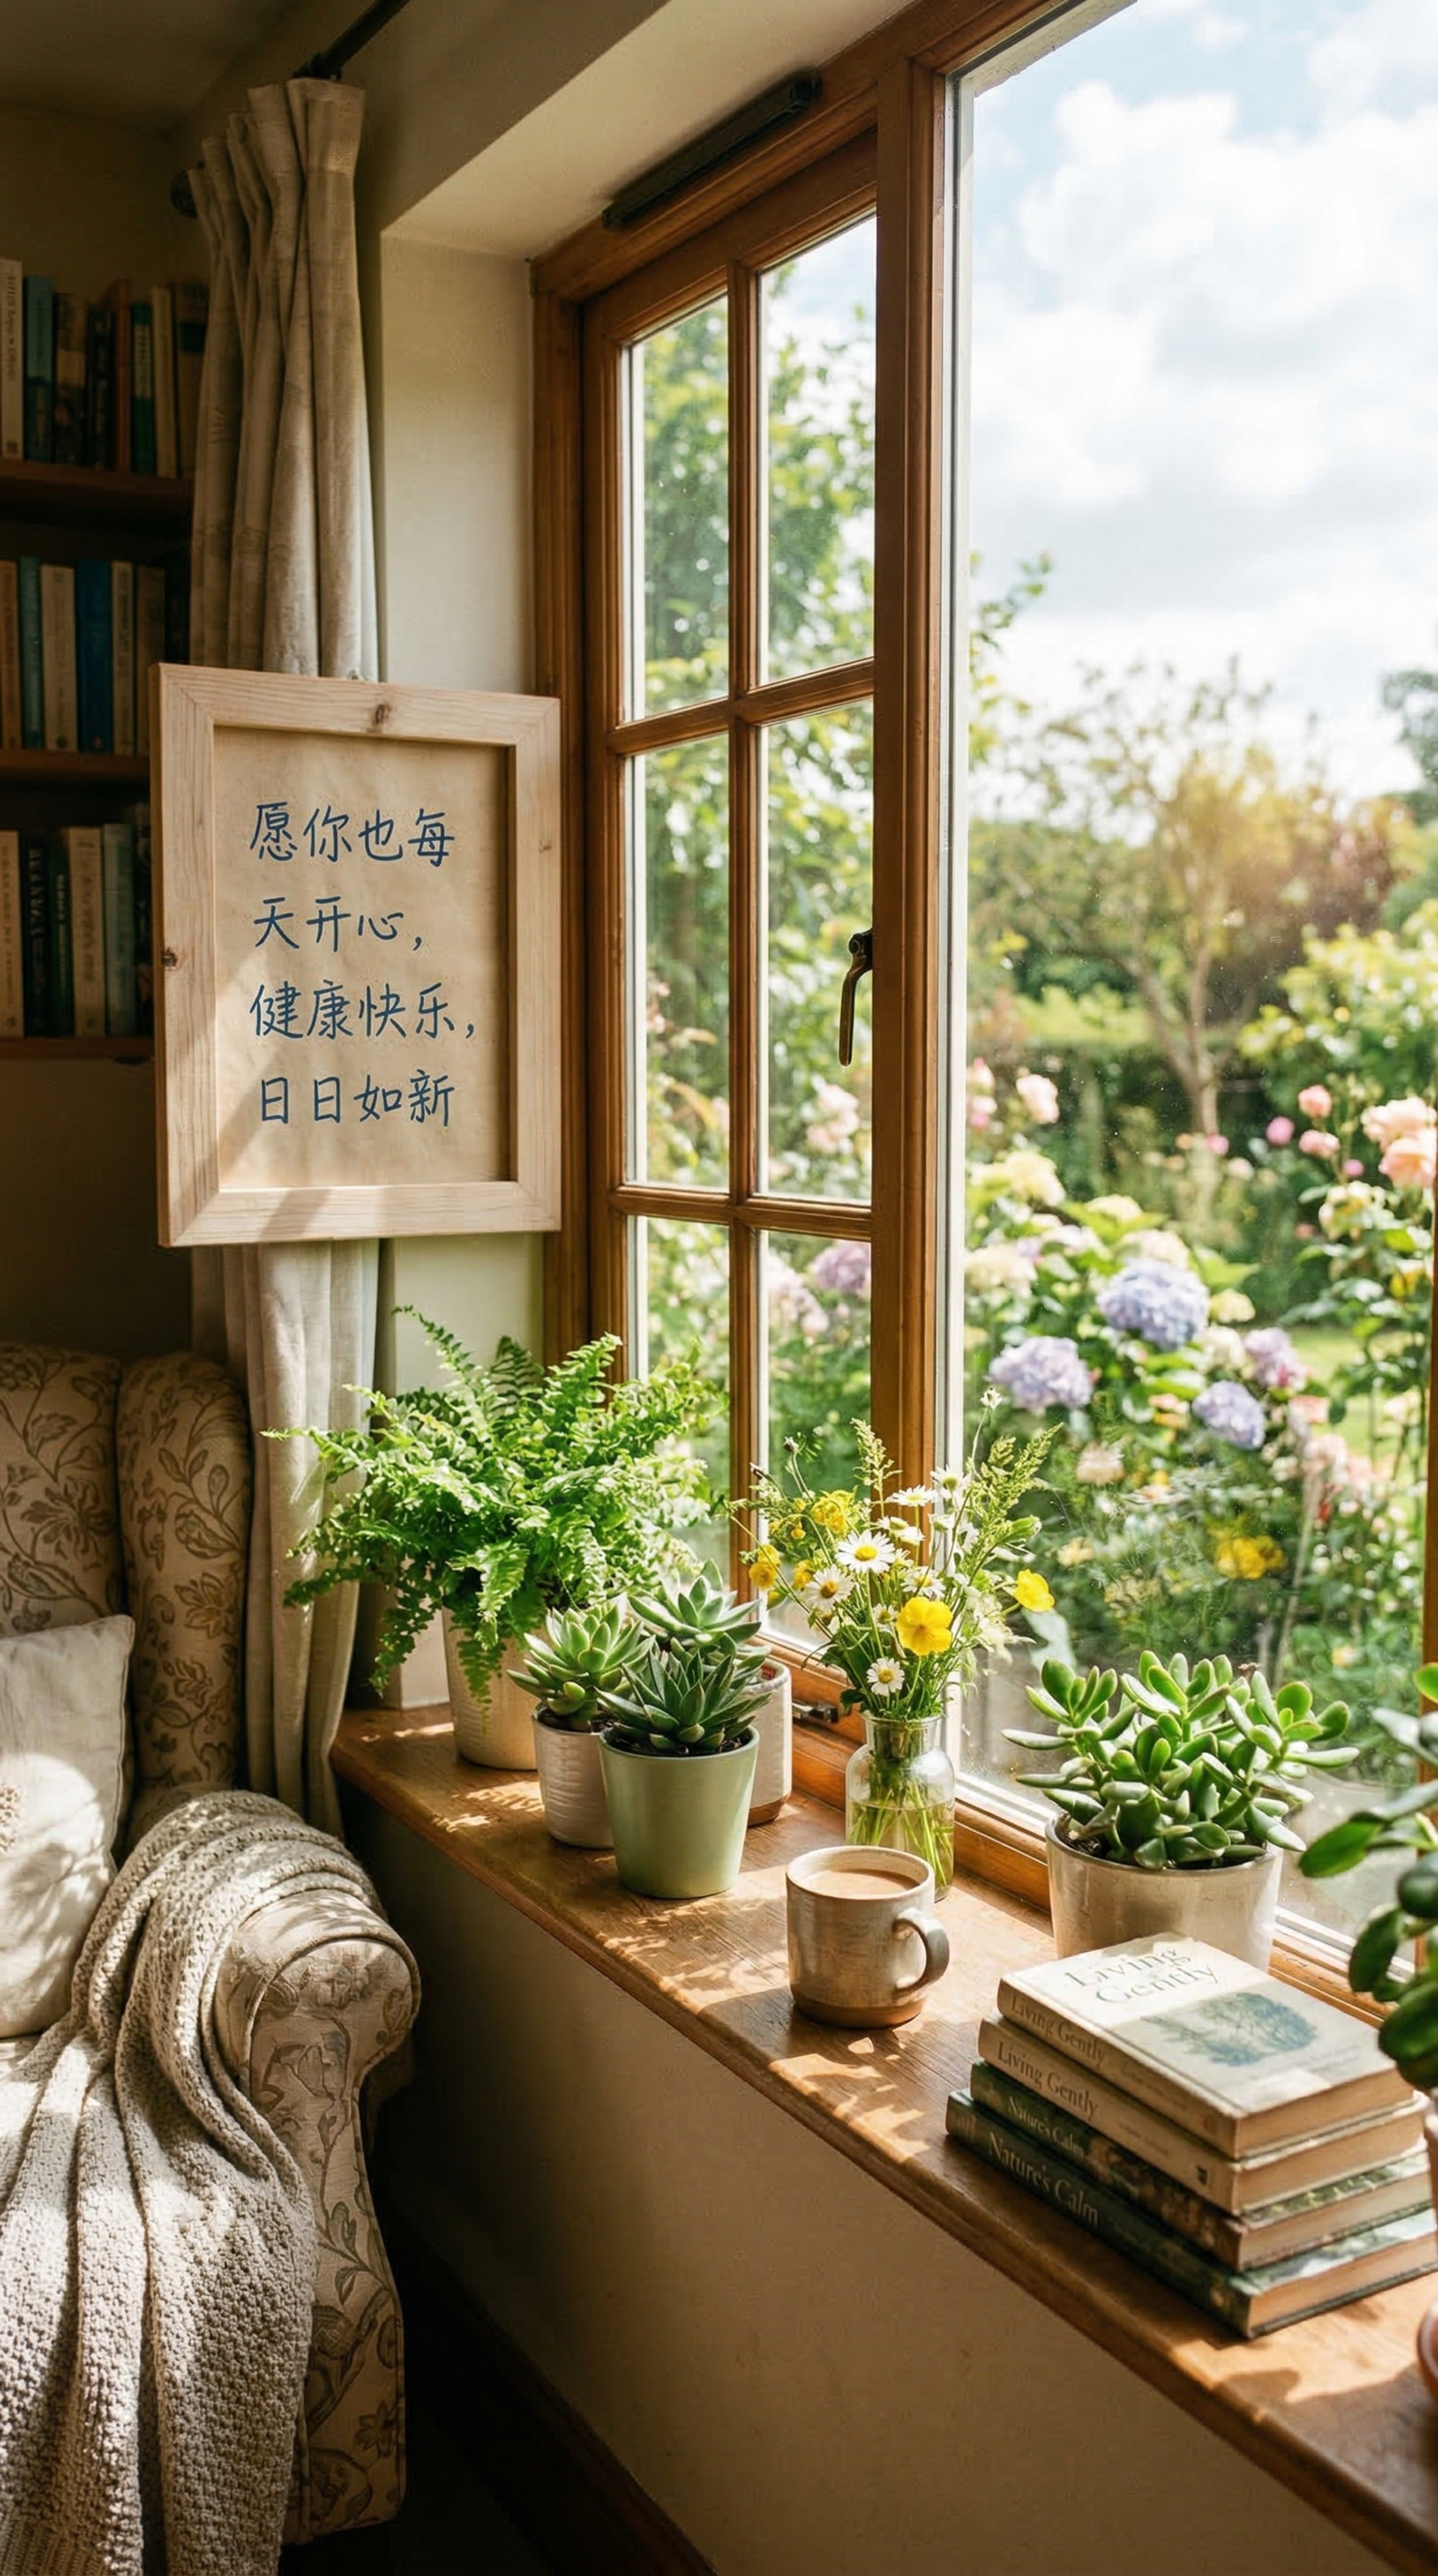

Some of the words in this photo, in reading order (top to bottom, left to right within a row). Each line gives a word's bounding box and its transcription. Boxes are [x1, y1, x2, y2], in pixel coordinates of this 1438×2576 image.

[250, 801, 455, 867] 愿你也每
[260, 1069, 455, 1127] 日日如新
[1064, 1949, 1191, 1987] Living
[1096, 1964, 1218, 2004] Gently
[1012, 1994, 1054, 2038] Living
[1057, 2021, 1105, 2068] Gently
[998, 2041, 1043, 2090] Living
[1047, 2072, 1099, 2121] Gently
[1052, 2126, 1084, 2158] Calm
[989, 2131, 1051, 2192] Nature's
[1054, 2179, 1098, 2227] Calm
